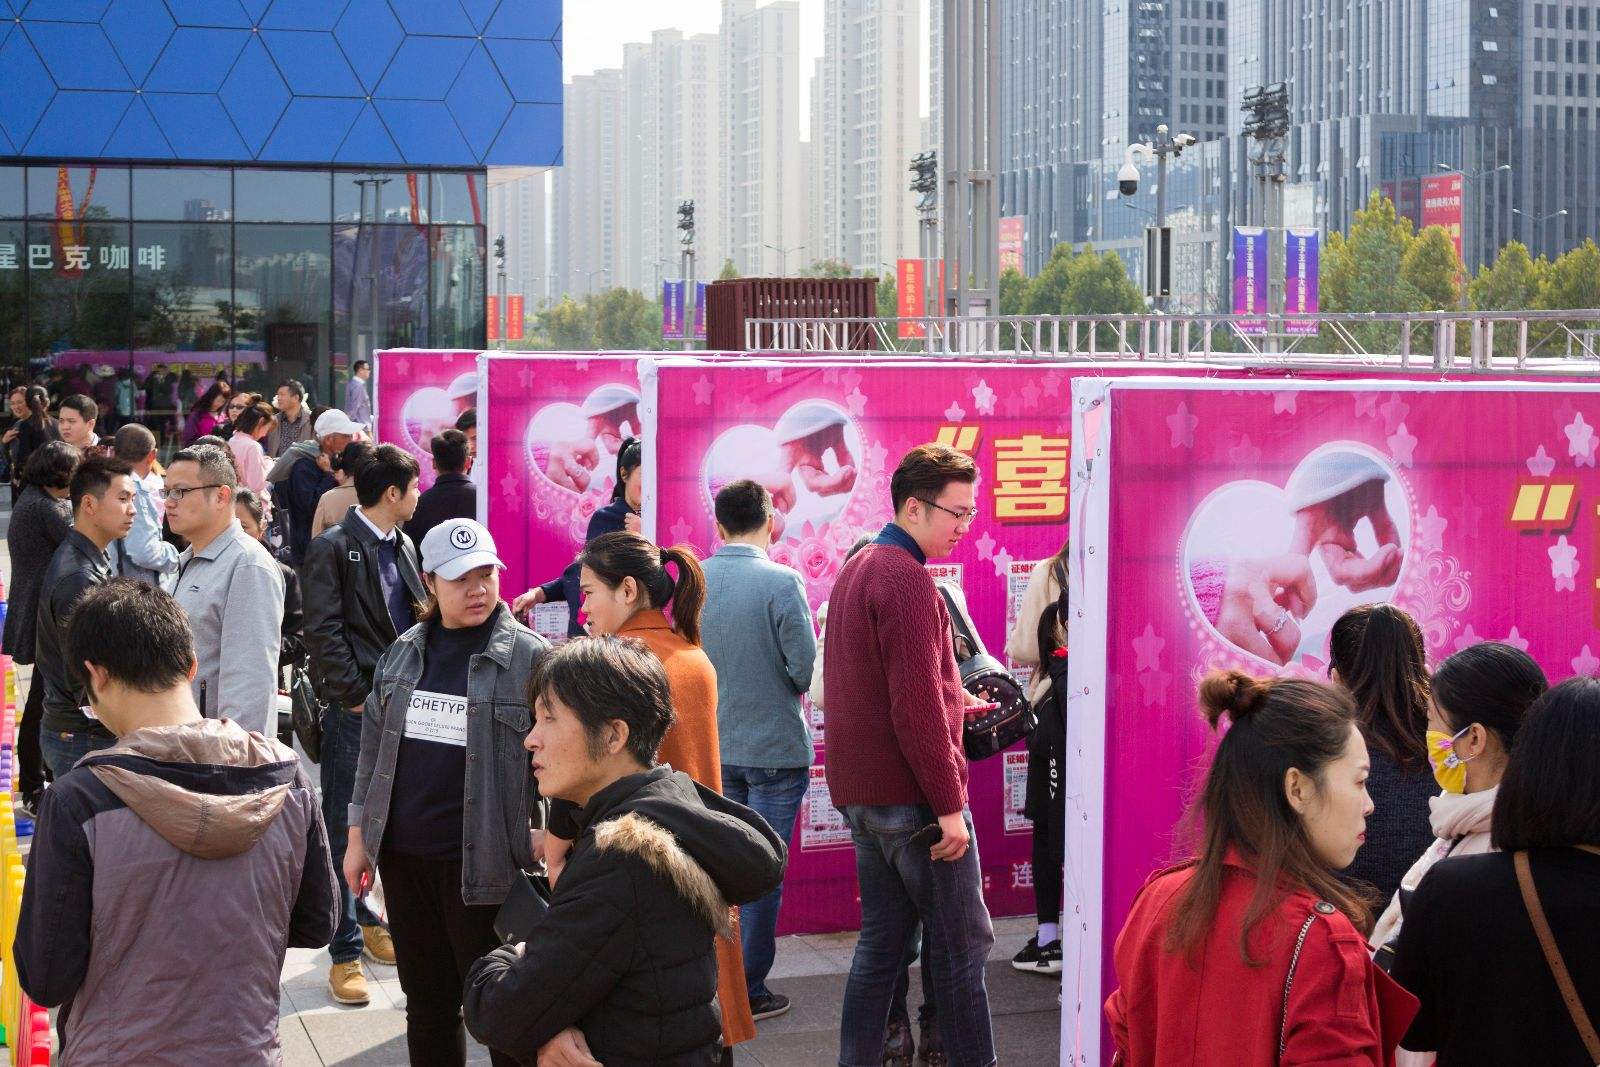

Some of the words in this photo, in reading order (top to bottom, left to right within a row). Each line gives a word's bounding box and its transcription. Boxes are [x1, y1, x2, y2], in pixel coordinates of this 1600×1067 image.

[0, 244, 166, 270] 星巴克咖啡
[408, 697, 467, 715] CHETYP
